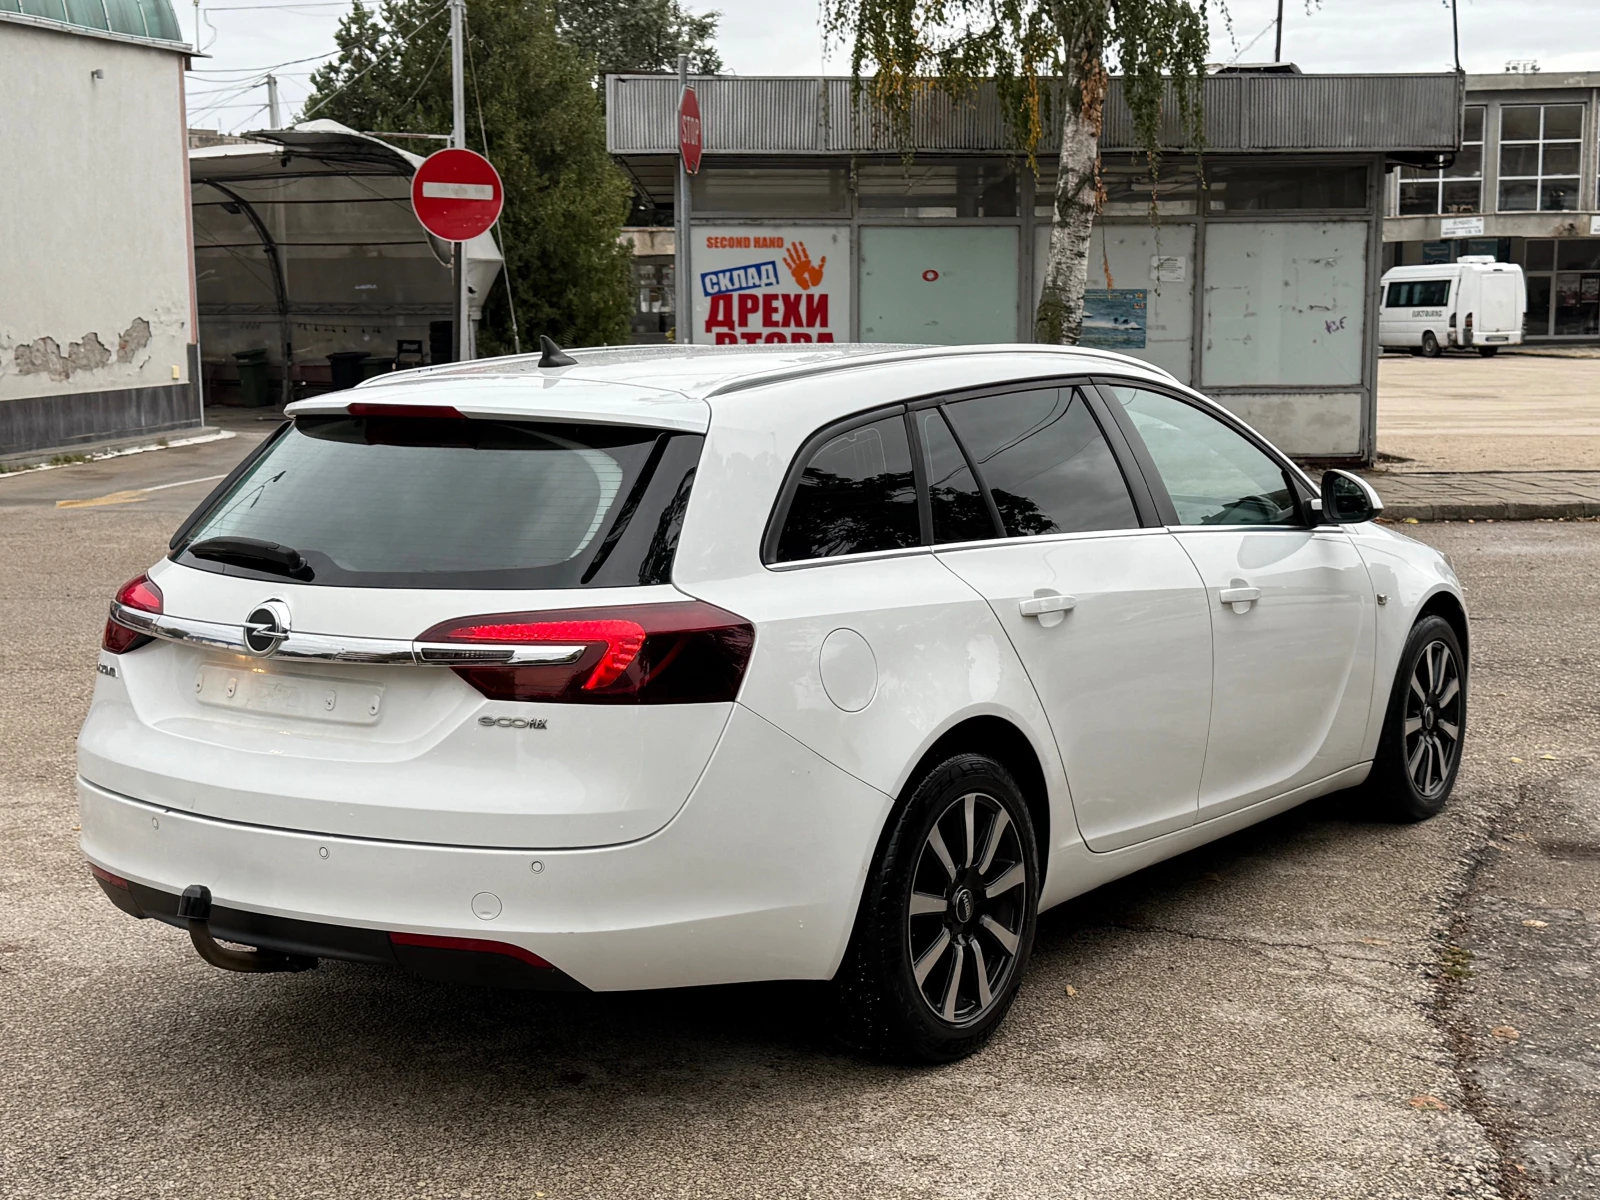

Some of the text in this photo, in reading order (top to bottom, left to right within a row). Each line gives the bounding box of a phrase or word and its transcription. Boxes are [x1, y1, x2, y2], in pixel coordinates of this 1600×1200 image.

[682, 114, 700, 146] STOP
[706, 237, 784, 249] SECOND HAND
[704, 264, 777, 294] СКЛАД
[705, 293, 829, 333] ДРЕХИ
